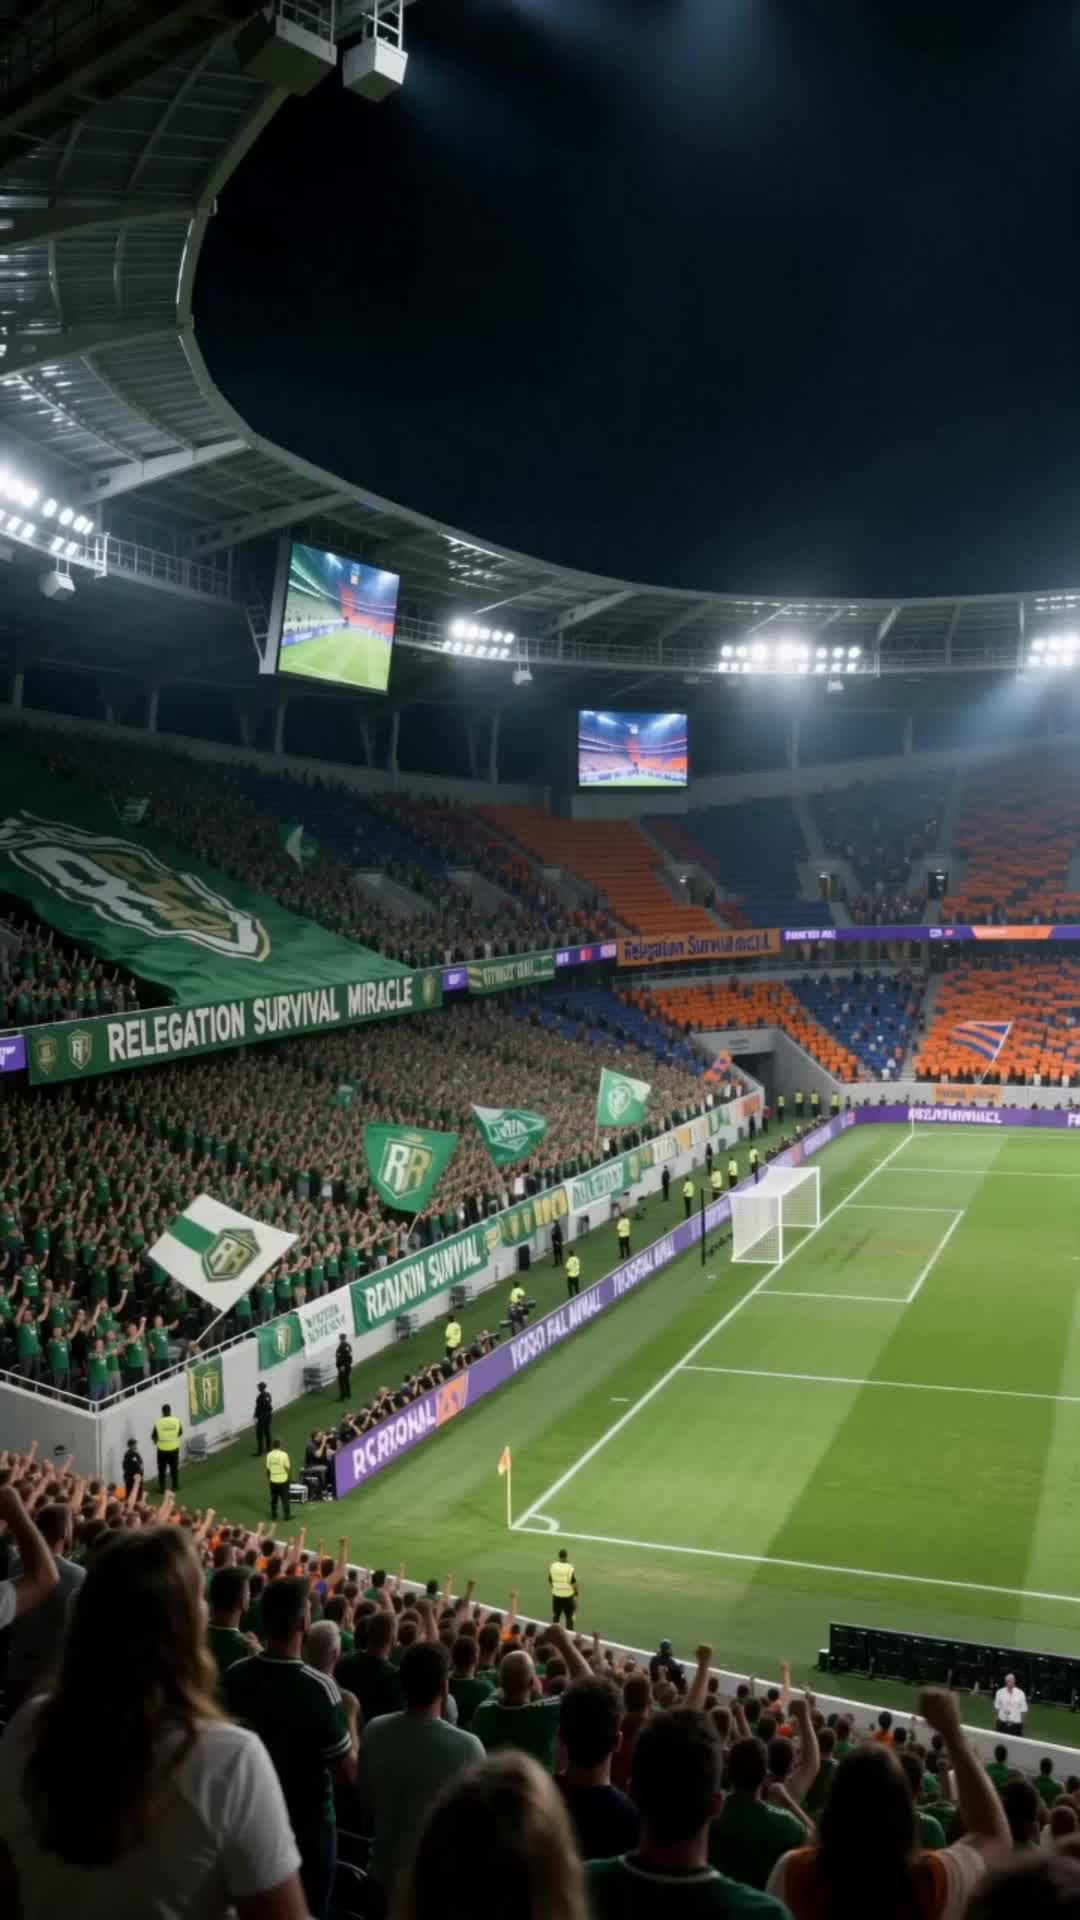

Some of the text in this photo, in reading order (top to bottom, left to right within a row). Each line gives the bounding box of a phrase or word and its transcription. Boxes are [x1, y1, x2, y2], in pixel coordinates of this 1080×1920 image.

[107, 977, 413, 1062] RELEGATION SURVIVAL MIRACLE
